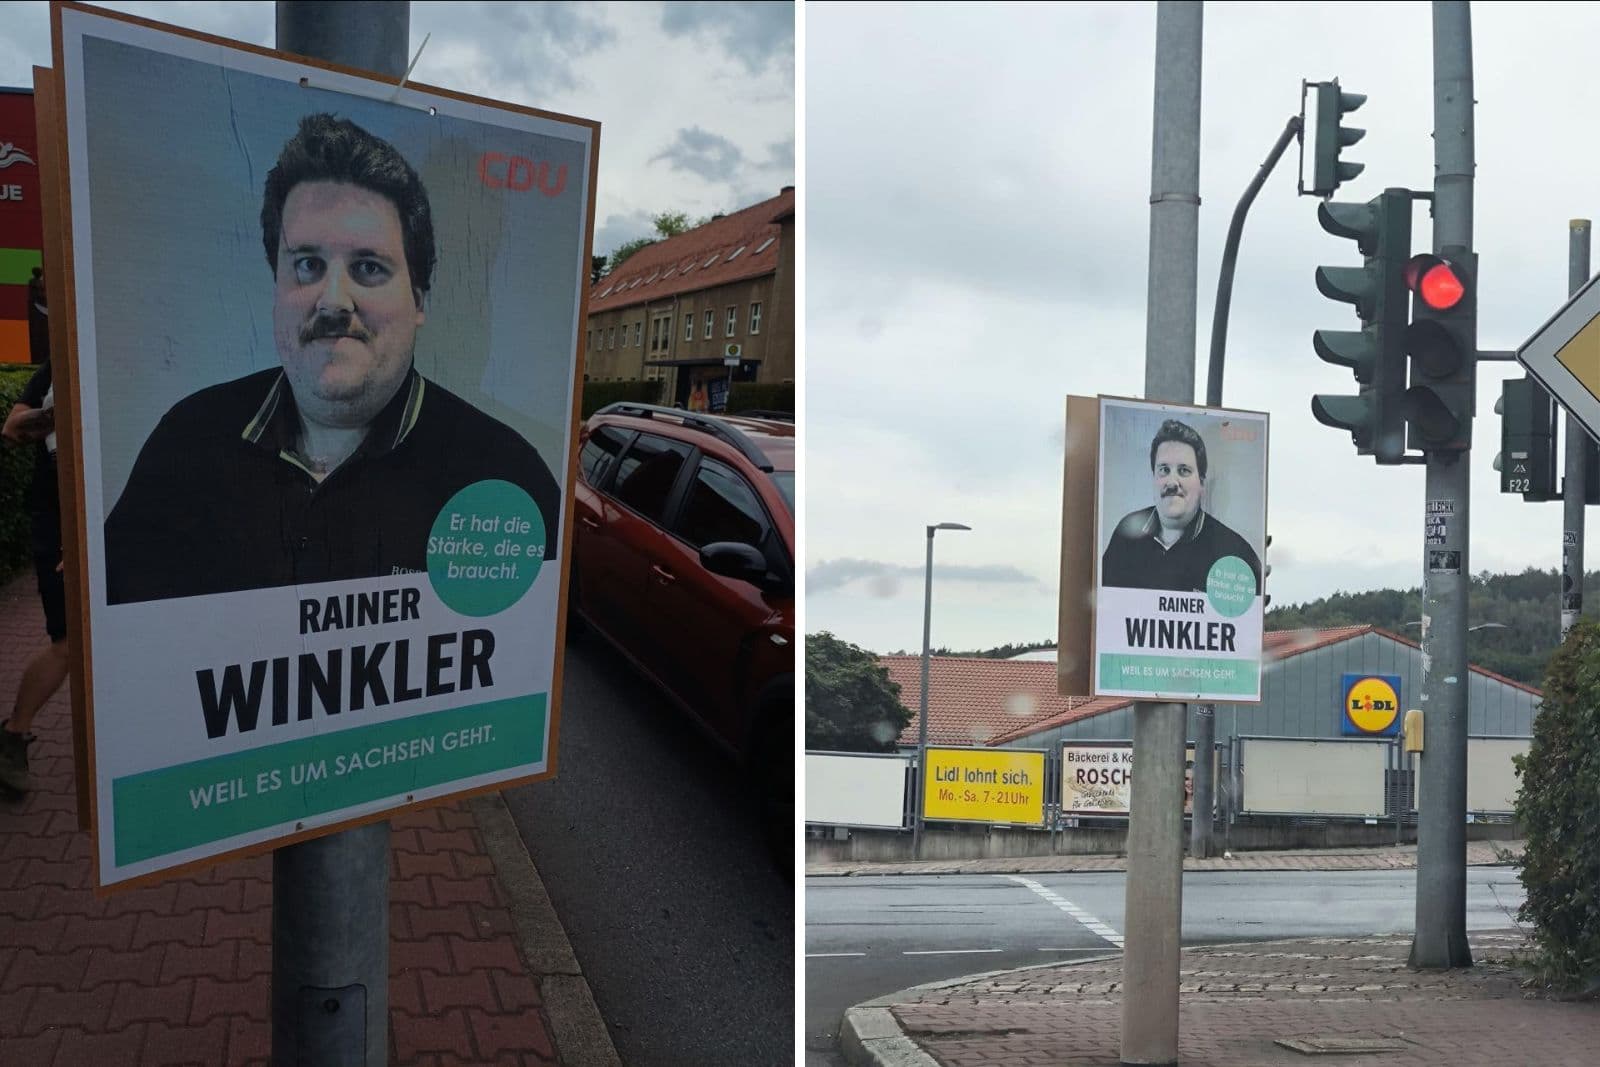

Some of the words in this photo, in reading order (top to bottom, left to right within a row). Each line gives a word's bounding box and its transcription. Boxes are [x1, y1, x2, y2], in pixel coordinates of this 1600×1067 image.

[477, 151, 569, 198] CDU
[450, 513, 467, 531] Er
[471, 514, 499, 532] hat
[504, 516, 531, 534] die
[427, 536, 489, 558] Stärke,
[494, 539, 521, 557] die
[526, 543, 545, 557] es
[447, 562, 520, 580] braucht.
[299, 587, 421, 635] RAINER
[1158, 596, 1205, 614] RAINER
[1125, 617, 1236, 652] WINKLER
[1121, 665, 1140, 676] WEIL
[1143, 666, 1153, 676] ES
[1155, 667, 1169, 678] UM
[196, 628, 496, 739] WINKLER
[1351, 695, 1395, 712] LIDL
[189, 777, 248, 809] WEIL
[256, 770, 282, 794] ES
[290, 759, 328, 785] UM
[334, 735, 435, 776] SACHSEN
[441, 724, 496, 751] GEHT.
[1068, 752, 1109, 763] Bäckerei
[1112, 753, 1119, 763] &
[936, 765, 960, 782] Lidl
[964, 767, 997, 783] lohnt
[1002, 769, 1033, 786] sich.
